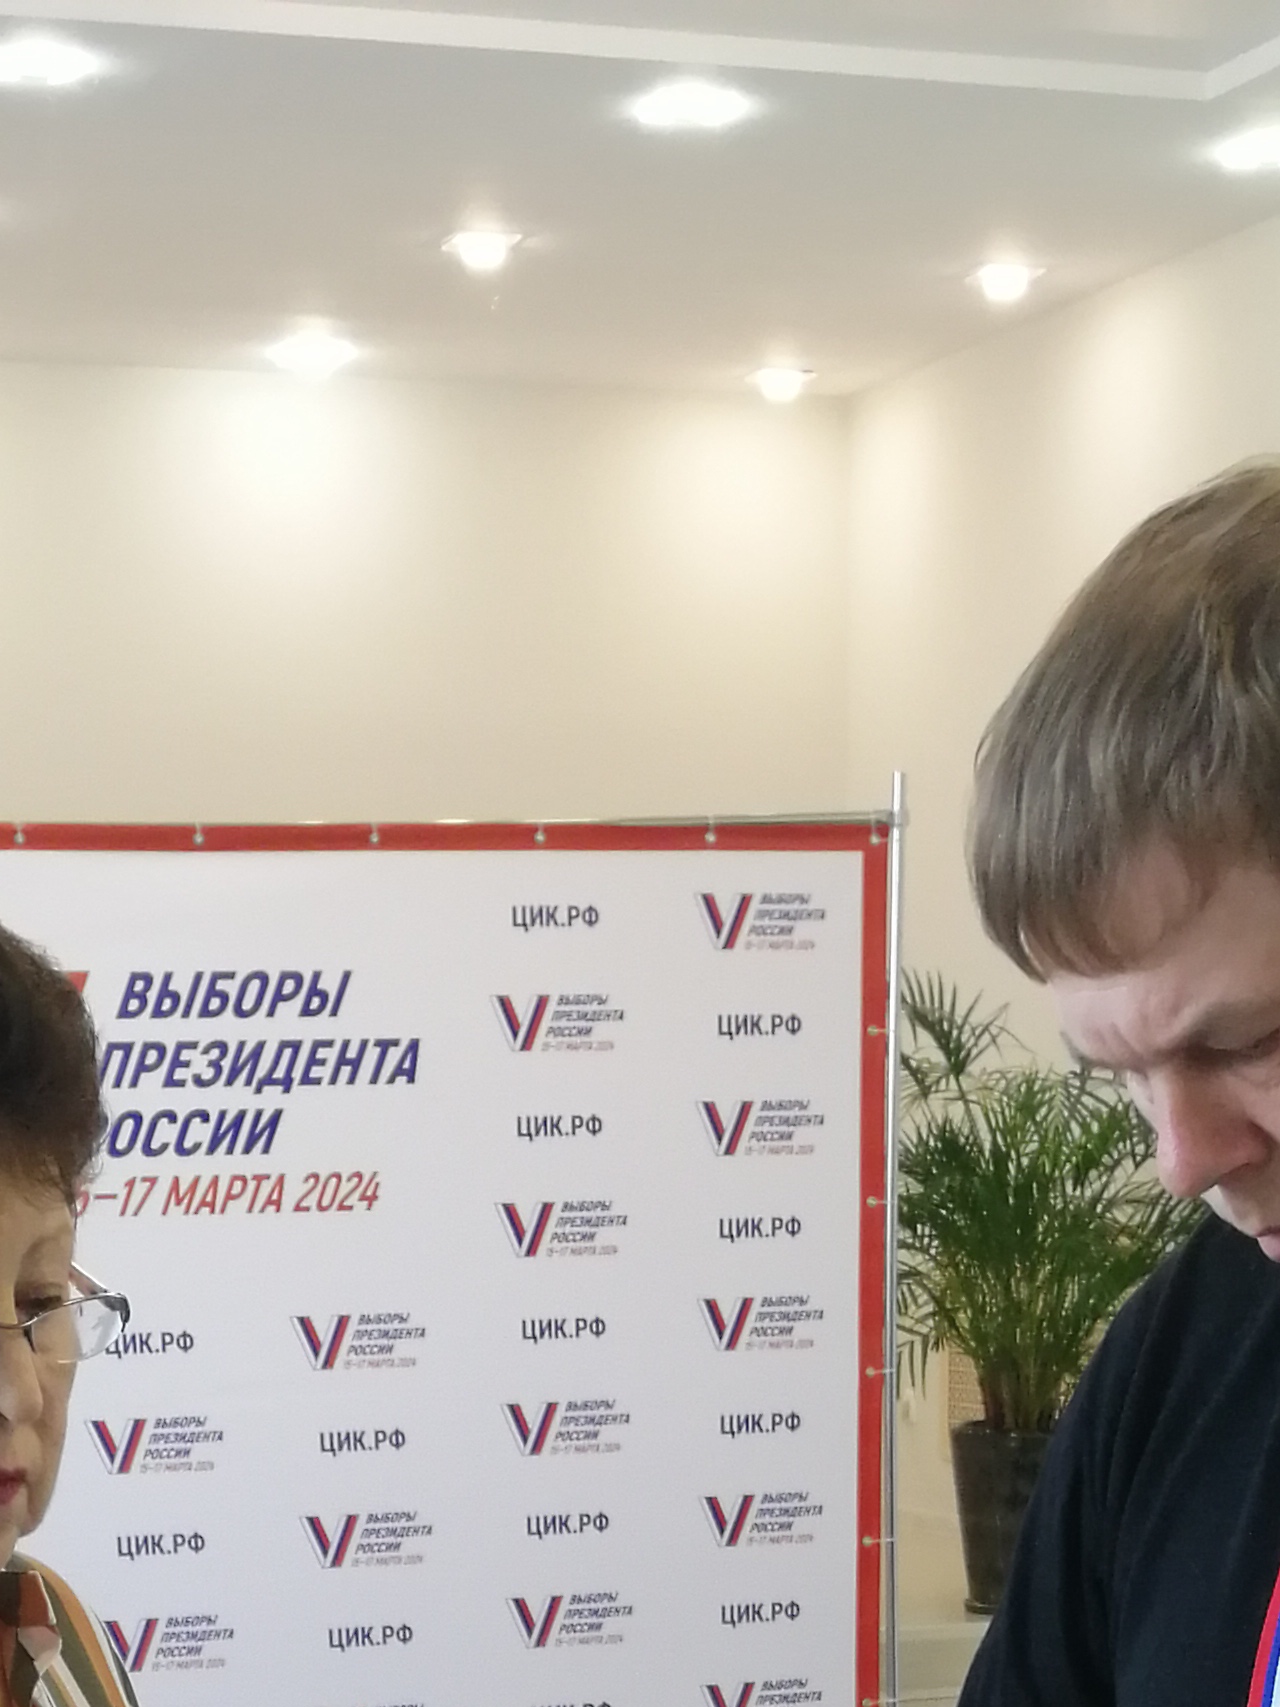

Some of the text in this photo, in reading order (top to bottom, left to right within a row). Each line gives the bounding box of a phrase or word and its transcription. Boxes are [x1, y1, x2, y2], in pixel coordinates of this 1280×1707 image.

[512, 904, 599, 931] ЦИК.РФ
[116, 970, 352, 1019] ВЫБОРЫ
[718, 1013, 802, 1040] ЦИК.РФ
[98, 1038, 421, 1094] ПРЕЗИДЕНТА
[105, 1108, 283, 1158] ОССИИ
[516, 1114, 603, 1142] ЦИК.РФ
[162, 1173, 286, 1216] МАРТА
[292, 1171, 380, 1213] 2024
[719, 1216, 802, 1243] ЦИК.РФ
[521, 1317, 606, 1344] ЦИК.РФ
[720, 1412, 801, 1438] ЦИК.РФ
[320, 1428, 406, 1456] ЦИК.РФ
[526, 1512, 609, 1540] ЦИК.РФ
[117, 1532, 206, 1560] ЦИК.РФ
[721, 1601, 800, 1627] ЦИК.РФ
[328, 1624, 413, 1652] ЦИК.РФ
